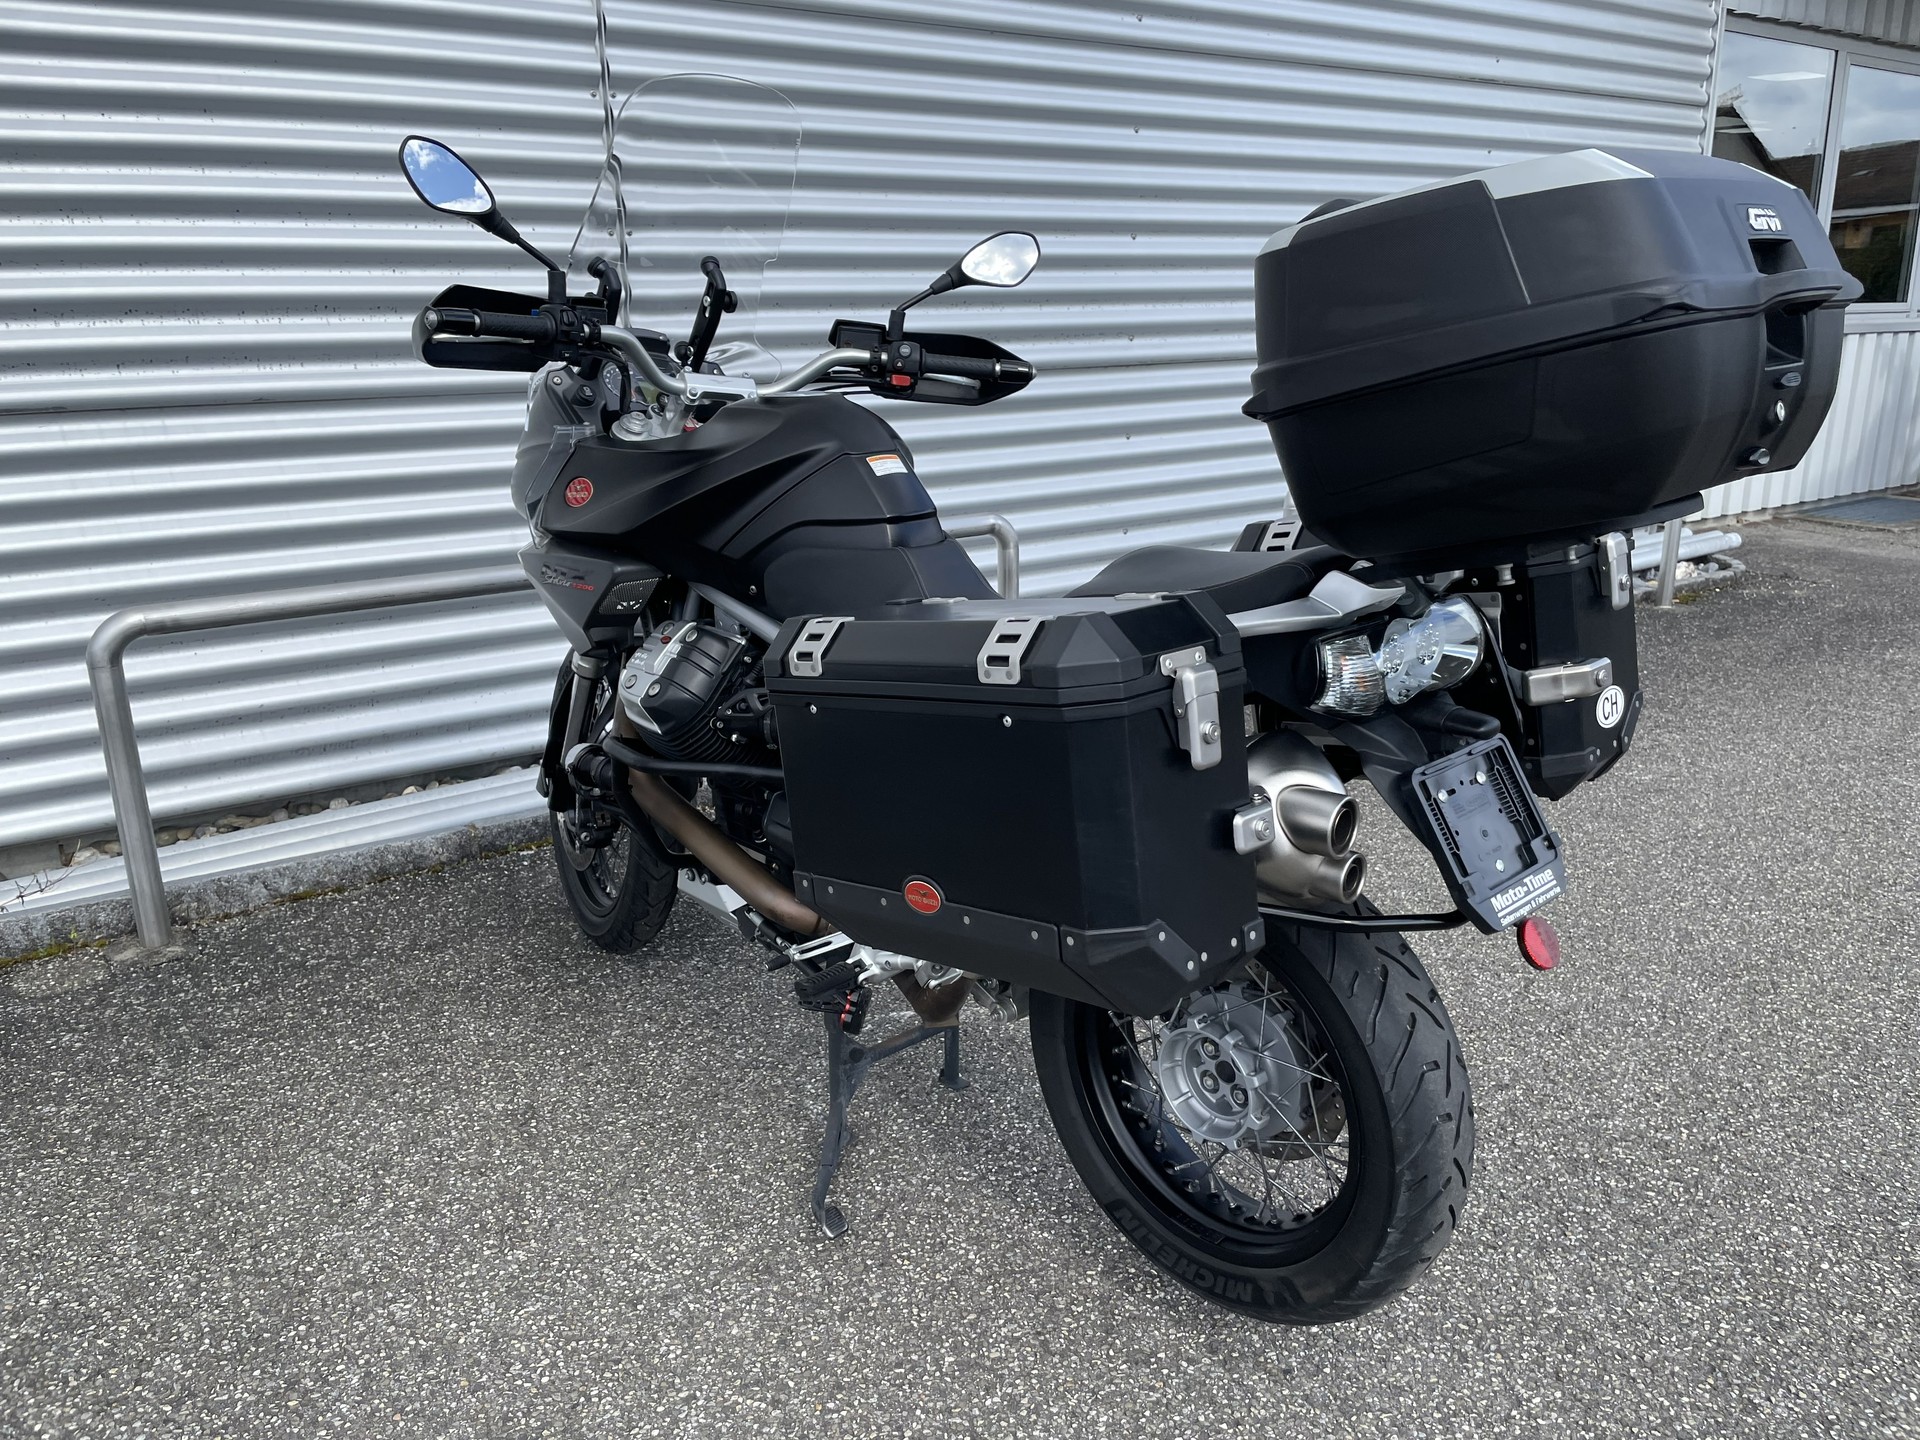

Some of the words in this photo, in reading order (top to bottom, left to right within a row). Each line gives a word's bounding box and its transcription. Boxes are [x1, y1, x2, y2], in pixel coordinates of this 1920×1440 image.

[572, 582, 594, 591] 1200
[1602, 691, 1619, 721] CH
[908, 894, 922, 903] MOTO
[1490, 869, 1555, 912] Moto-Time
[1112, 1207, 1253, 1303] MICHELIN
